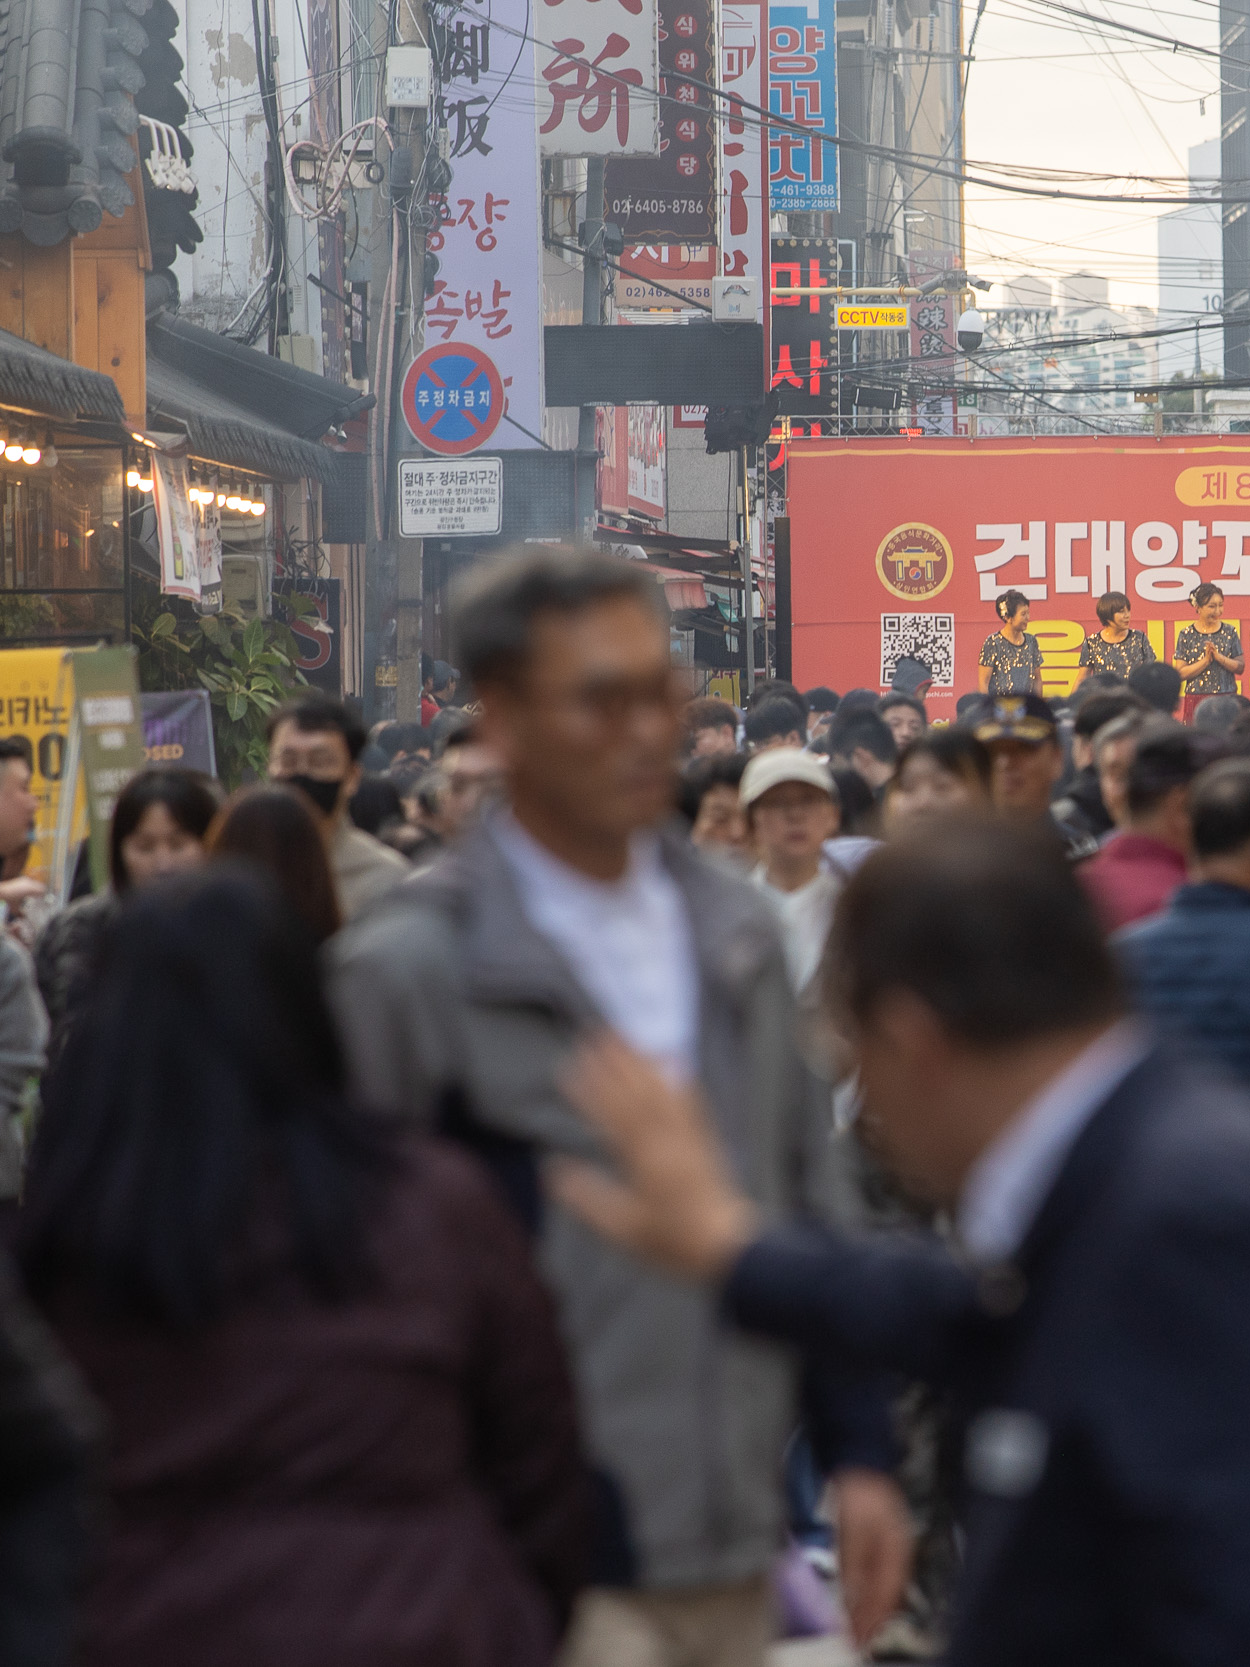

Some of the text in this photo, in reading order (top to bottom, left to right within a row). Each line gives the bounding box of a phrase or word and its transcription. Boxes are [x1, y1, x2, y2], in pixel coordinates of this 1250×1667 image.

[769, 26, 825, 182] 양꼬치
[612, 198, 704, 215] 02-6405-8786
[626, 286, 711, 298] 02)4625358
[424, 280, 512, 340] 족발
[839, 311, 904, 324] CCTV 작동중
[417, 389, 490, 407] 주정차금지
[404, 472, 424, 487] 절대
